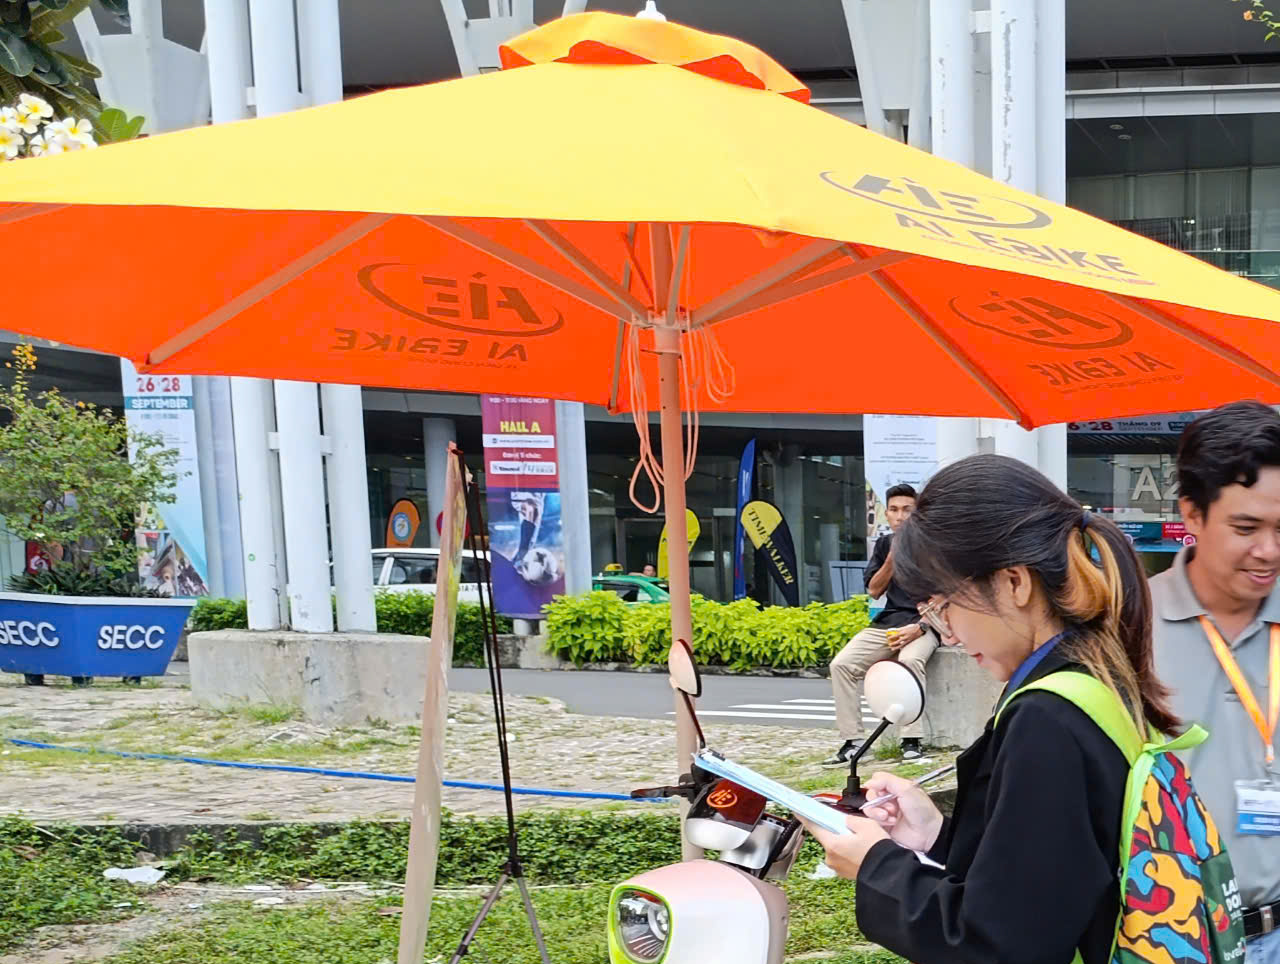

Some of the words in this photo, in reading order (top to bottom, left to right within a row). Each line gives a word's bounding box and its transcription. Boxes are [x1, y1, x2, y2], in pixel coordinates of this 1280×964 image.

[895, 212, 955, 238] AI
[968, 229, 1140, 277] EBIKE
[136, 377, 155, 392] 26
[161, 377, 181, 392] 28
[131, 398, 188, 409] SEPTEMBER
[500, 421, 530, 433] HALL
[530, 421, 541, 433] A
[1087, 421, 1113, 431] 28
[98, 625, 165, 649] SECC
